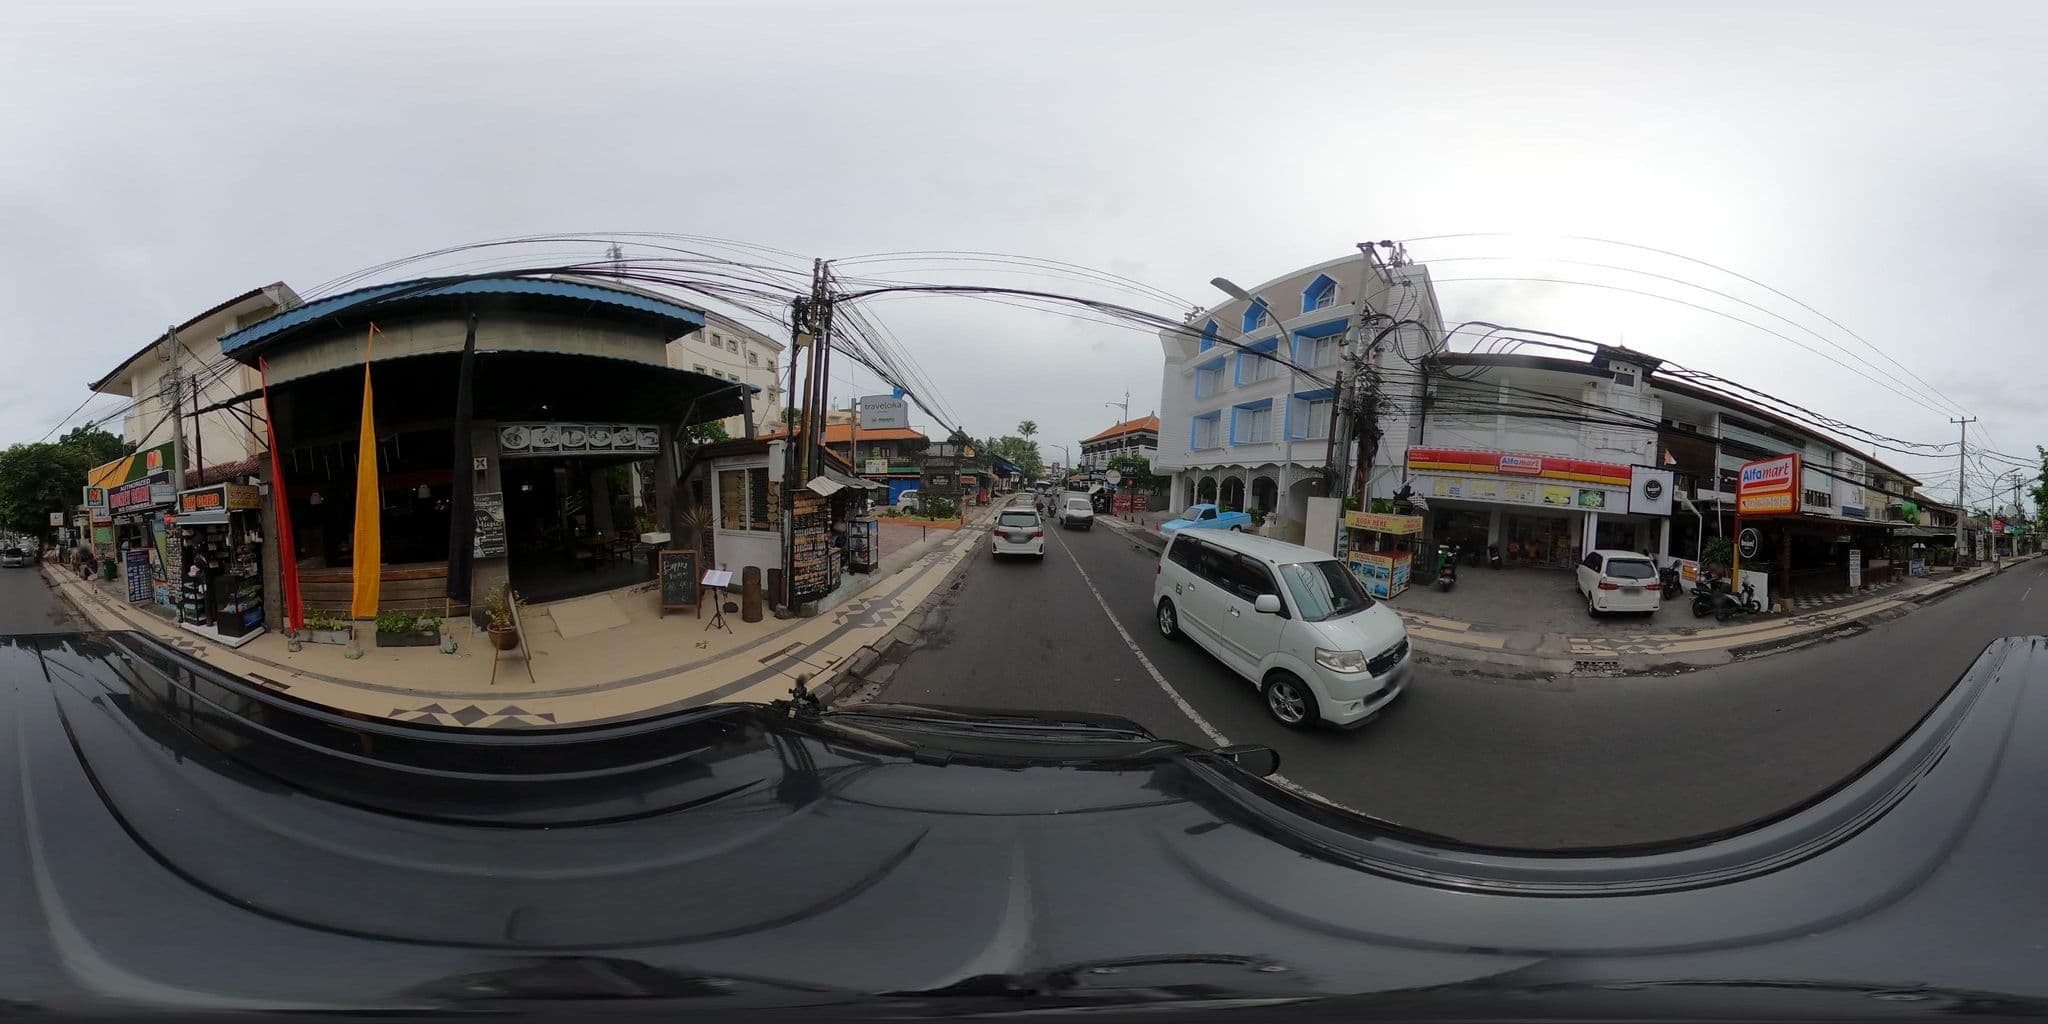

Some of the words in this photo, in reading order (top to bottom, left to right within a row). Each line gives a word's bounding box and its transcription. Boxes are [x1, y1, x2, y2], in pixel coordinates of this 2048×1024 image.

[865, 401, 902, 410] traveloka
[1501, 457, 1539, 468] Alfamart
[1743, 463, 1790, 482] Alfamart
